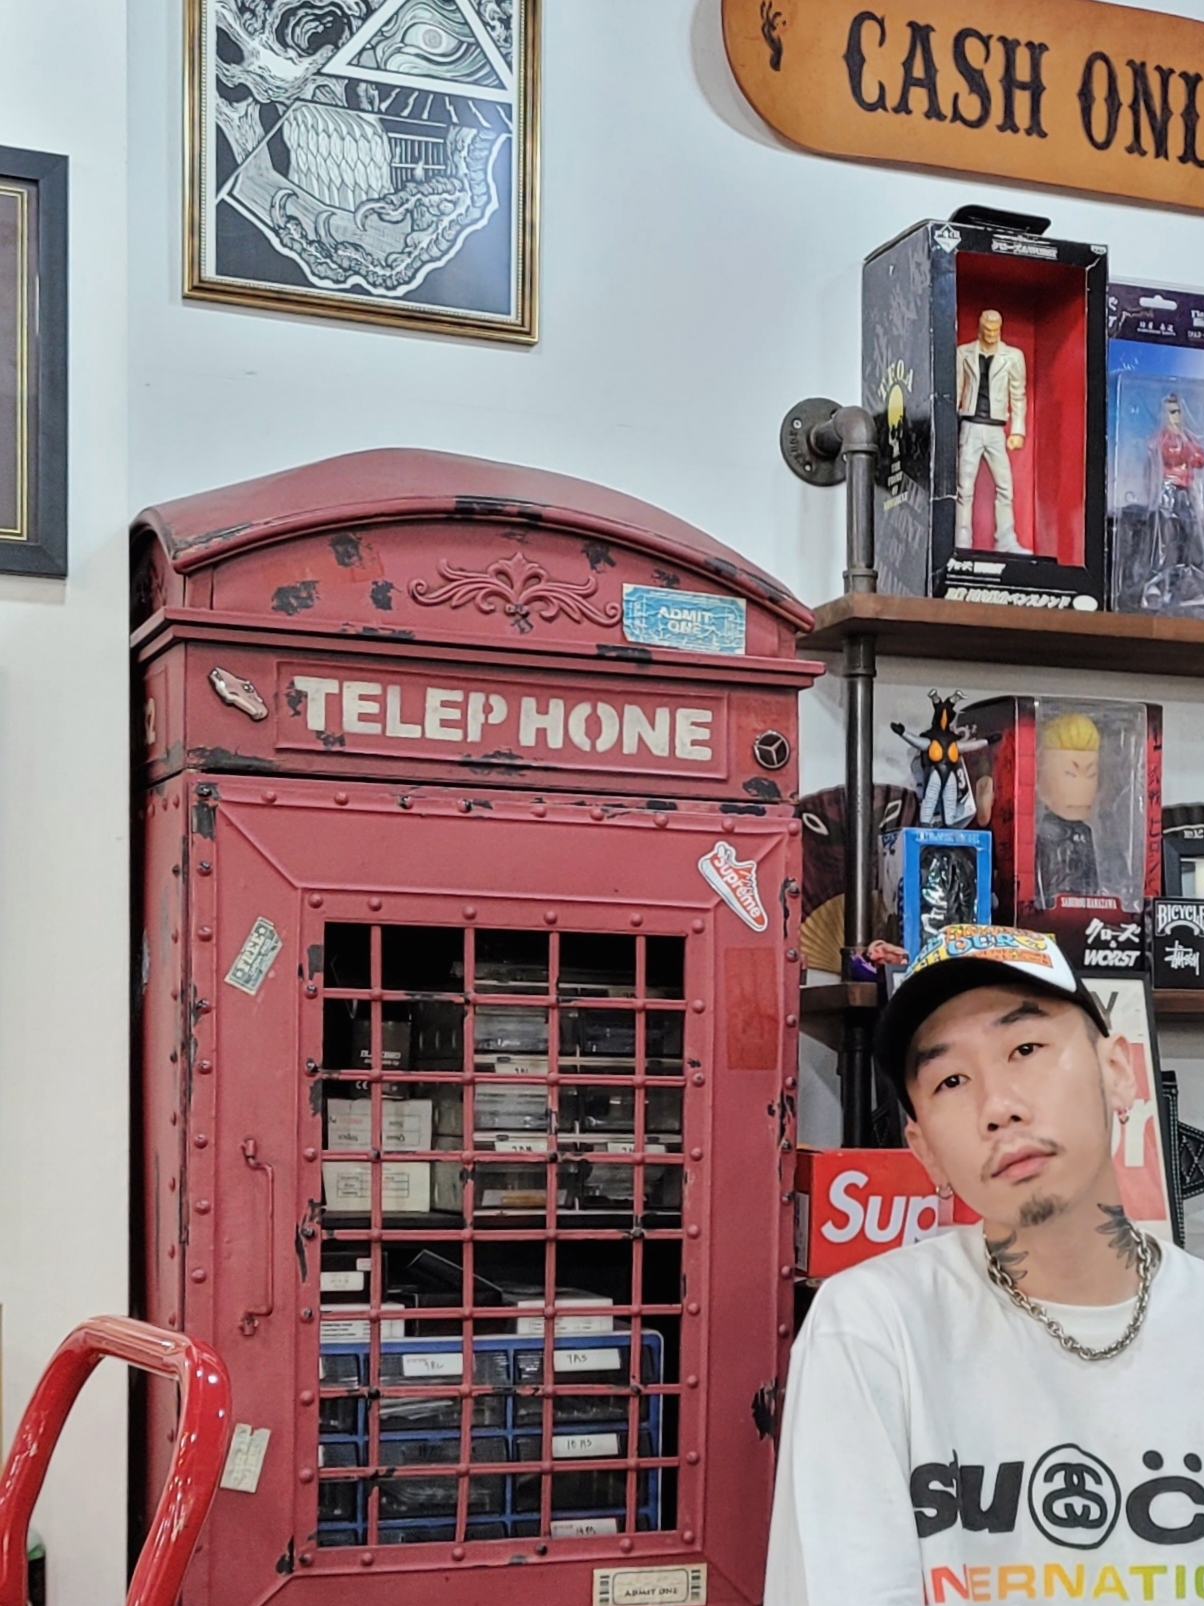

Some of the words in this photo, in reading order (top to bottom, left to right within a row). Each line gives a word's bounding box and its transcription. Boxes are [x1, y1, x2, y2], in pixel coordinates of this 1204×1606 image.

[842, 11, 1049, 138] CASH
[658, 606, 713, 624] ADMIT
[667, 620, 702, 635] ONE
[712, 854, 761, 918] Supreme
[1084, 949, 1141, 967] WORST
[624, 1587, 656, 1598] ADMIT
